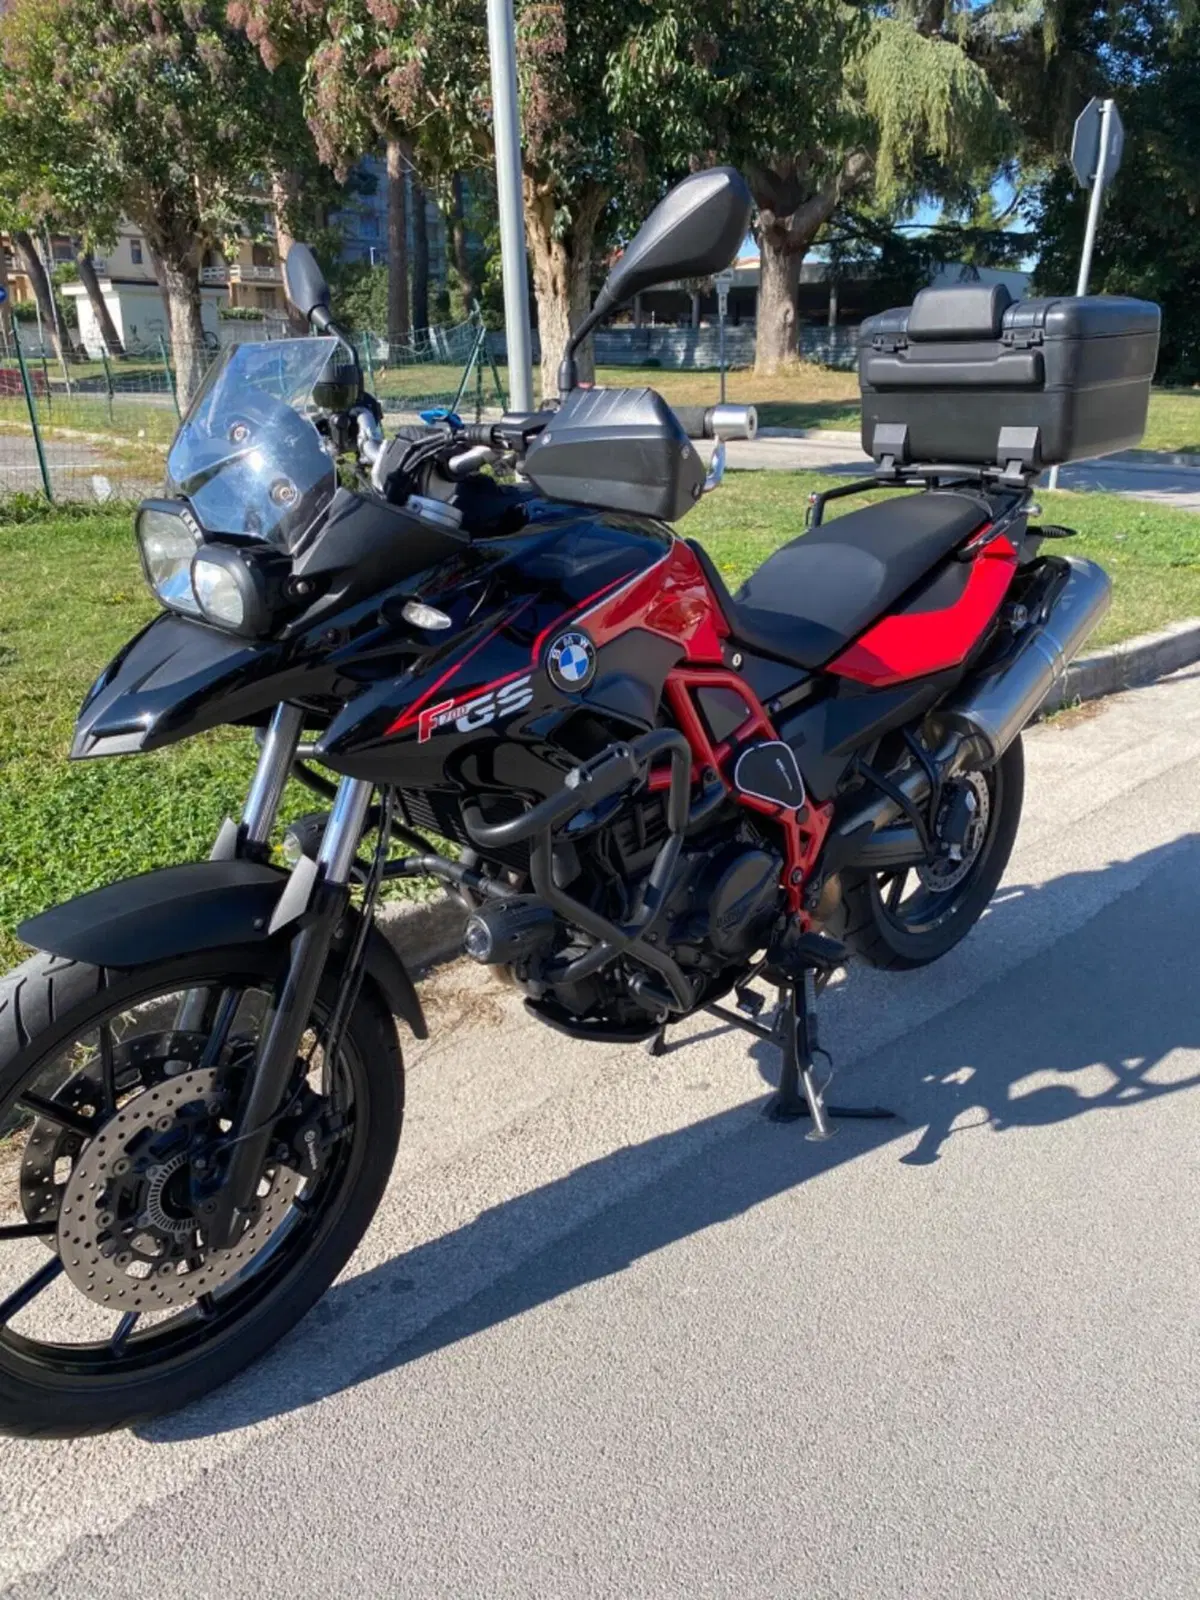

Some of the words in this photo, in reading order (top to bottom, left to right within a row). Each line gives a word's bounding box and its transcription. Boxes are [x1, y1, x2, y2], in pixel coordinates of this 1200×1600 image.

[551, 635, 589, 660] BMW
[418, 698, 455, 743] F
[456, 675, 533, 732] GS
